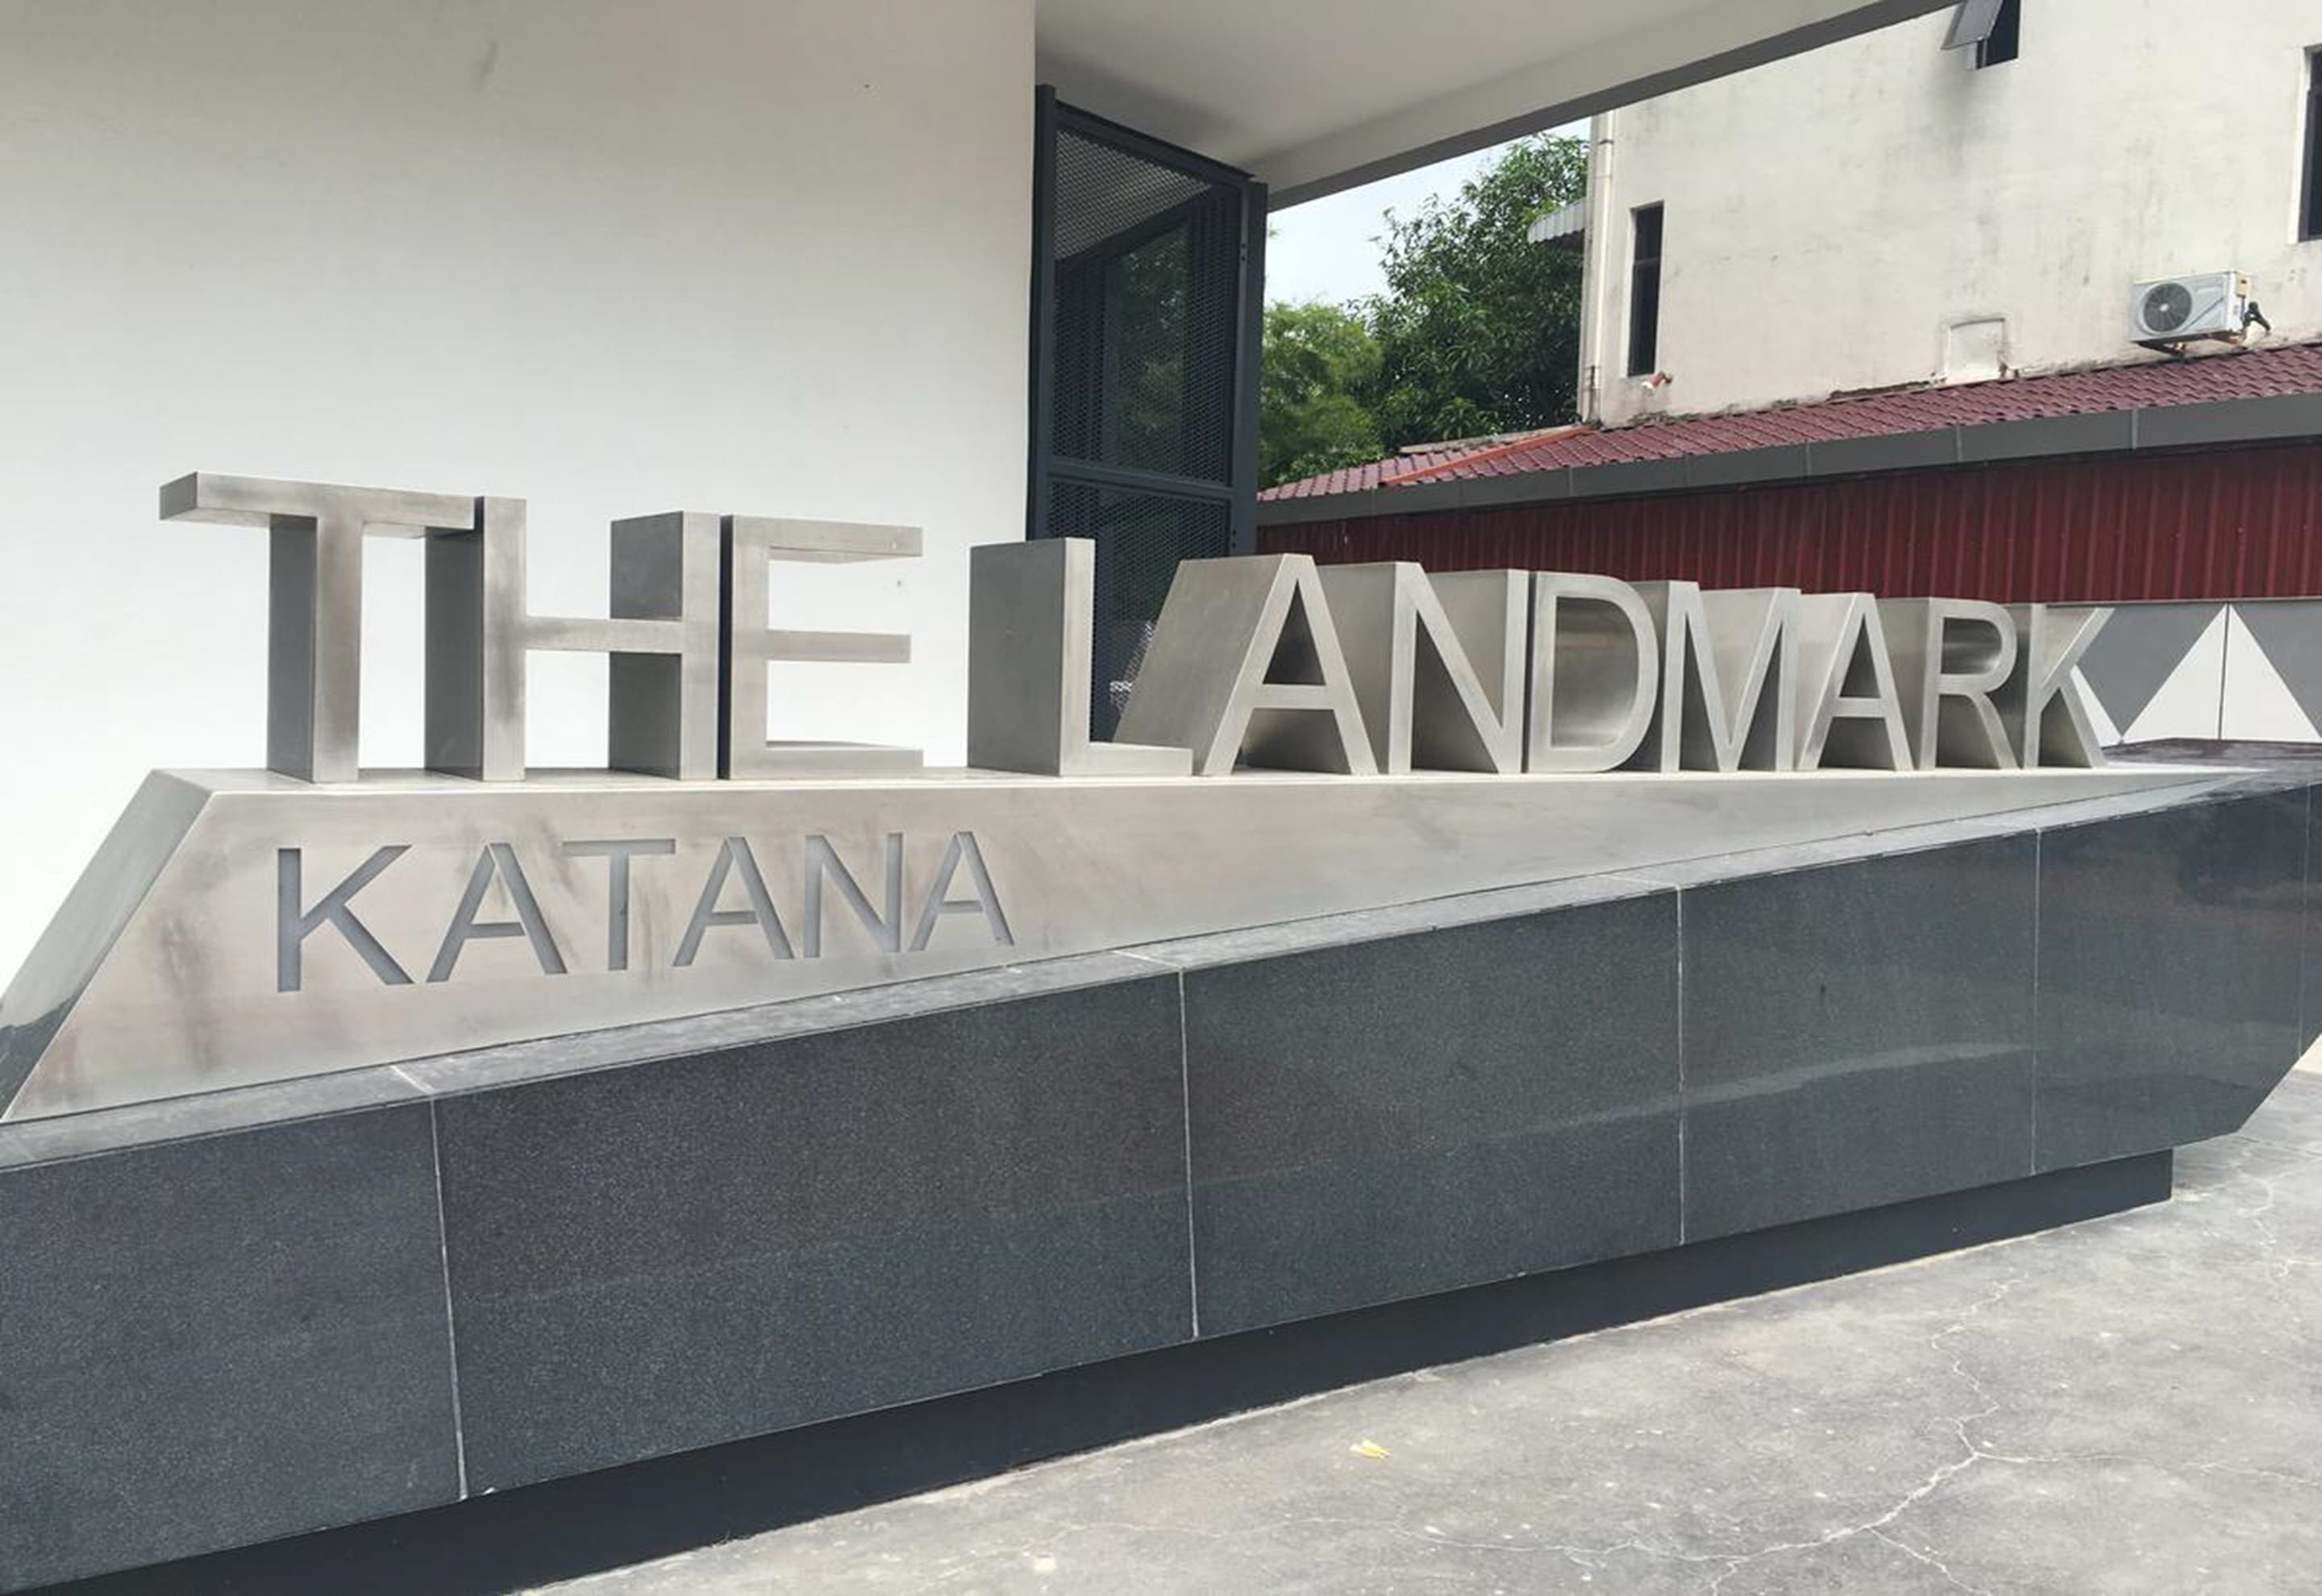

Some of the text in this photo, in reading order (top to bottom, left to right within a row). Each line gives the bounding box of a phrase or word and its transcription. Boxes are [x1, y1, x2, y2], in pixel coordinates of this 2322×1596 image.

[160, 472, 2114, 781] THE LANDMARK
[277, 831, 1014, 992] KATANA
